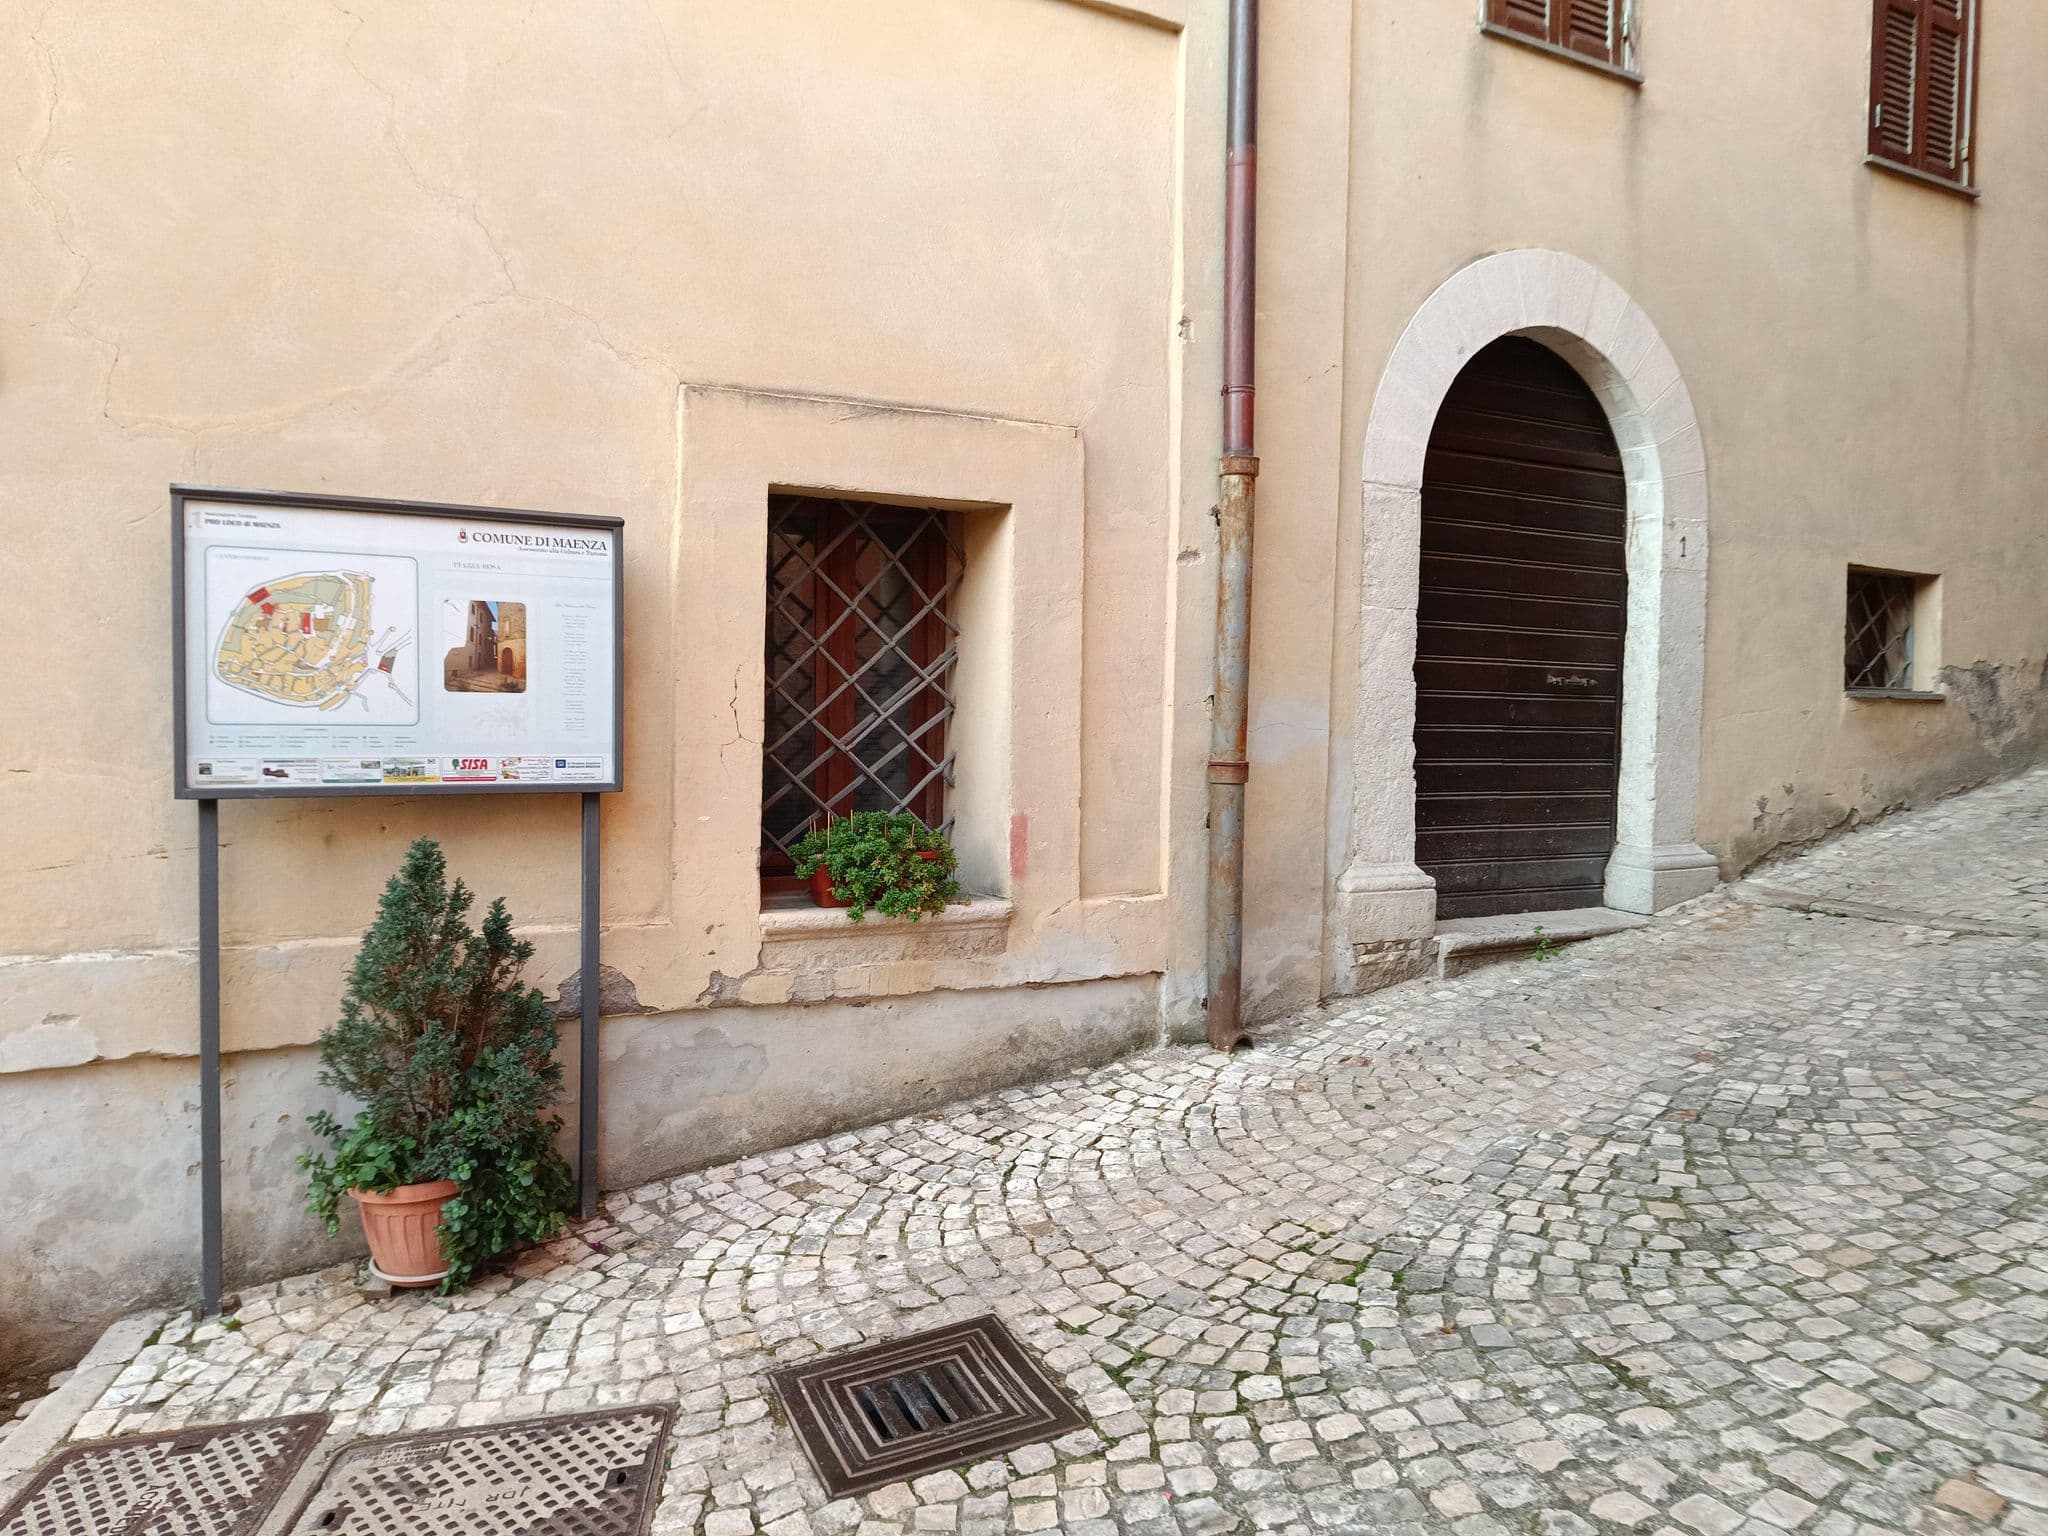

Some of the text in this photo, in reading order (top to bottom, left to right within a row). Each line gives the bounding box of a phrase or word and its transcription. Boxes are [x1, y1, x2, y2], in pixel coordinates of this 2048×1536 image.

[472, 532, 607, 551] COMUNE DI MAENZA
[1679, 536, 1686, 558] 1
[459, 758, 488, 770] SISA
